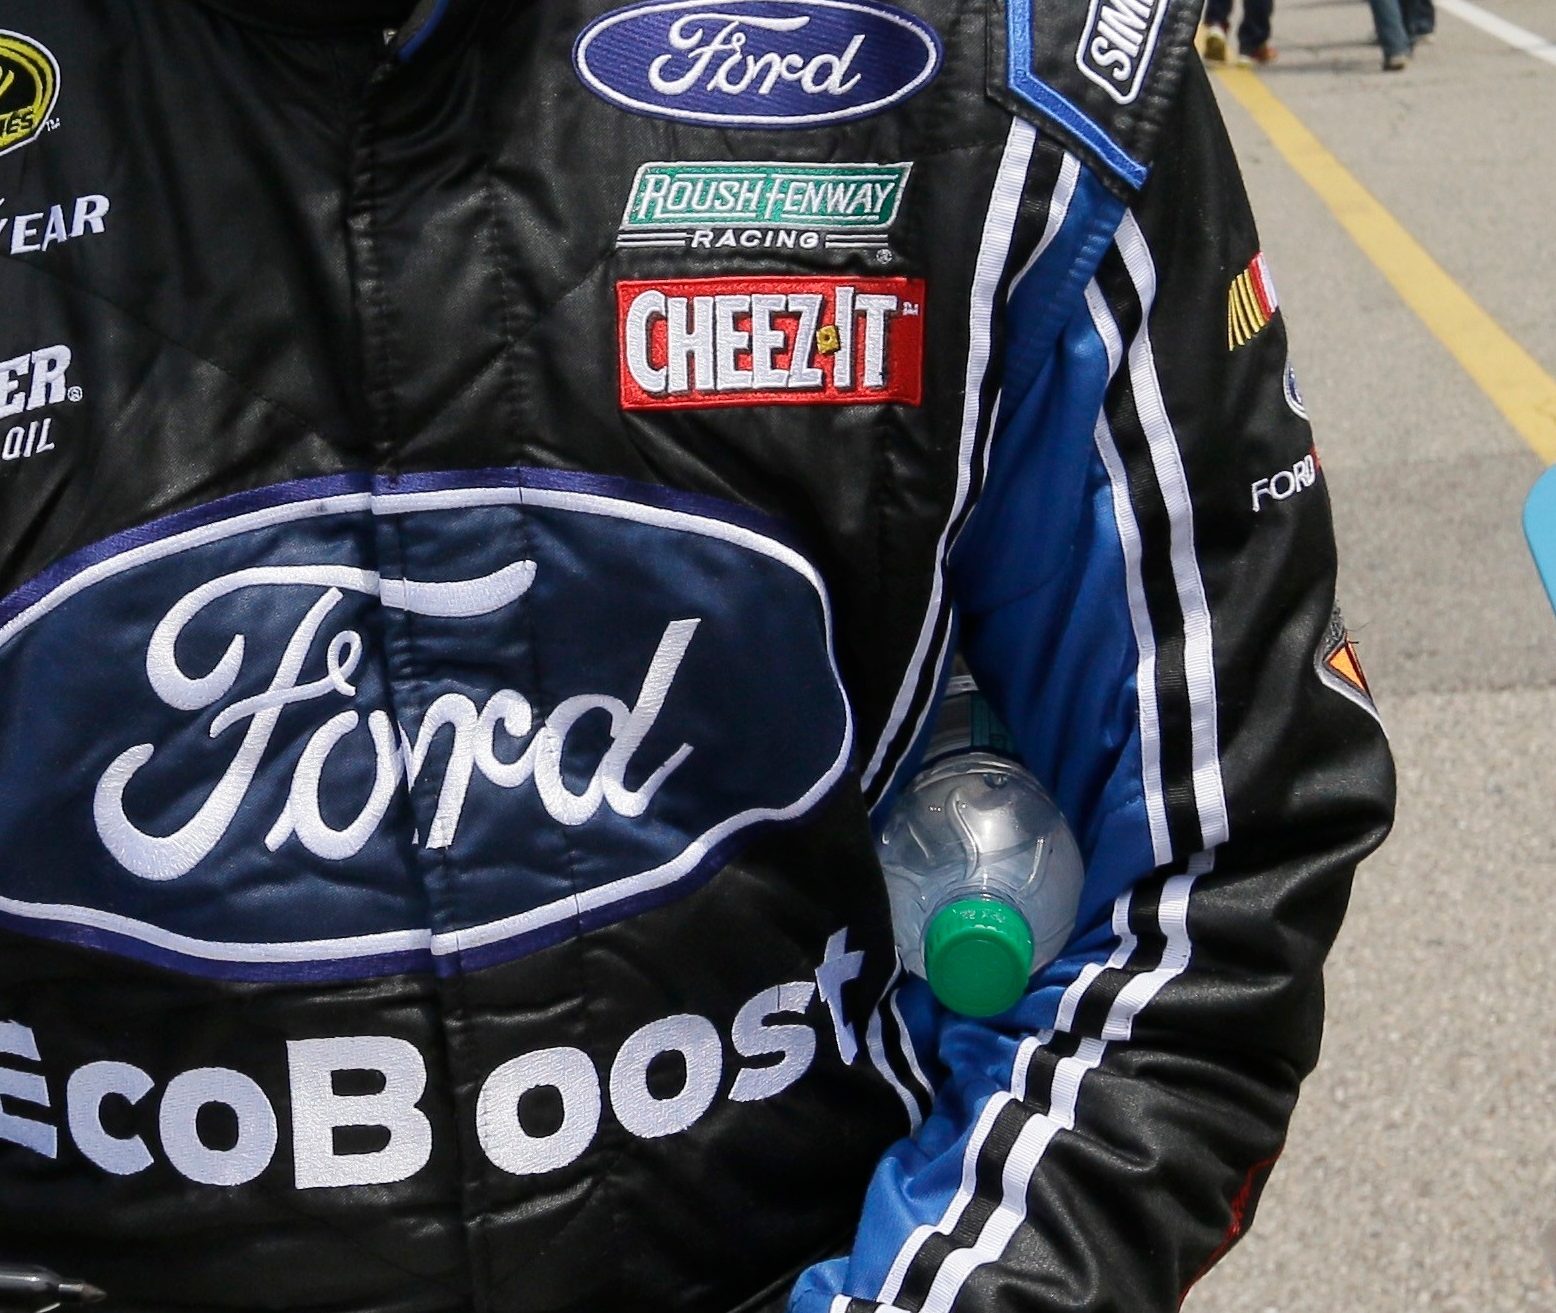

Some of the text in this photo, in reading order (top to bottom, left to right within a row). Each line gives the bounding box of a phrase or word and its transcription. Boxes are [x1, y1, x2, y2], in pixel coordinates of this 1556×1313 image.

[648, 12, 866, 96] Ford
[637, 173, 899, 221] ROUSH FENWAY
[691, 229, 820, 249] RACING
[1, 417, 55, 461] OIL
[93, 557, 702, 881] Ford
